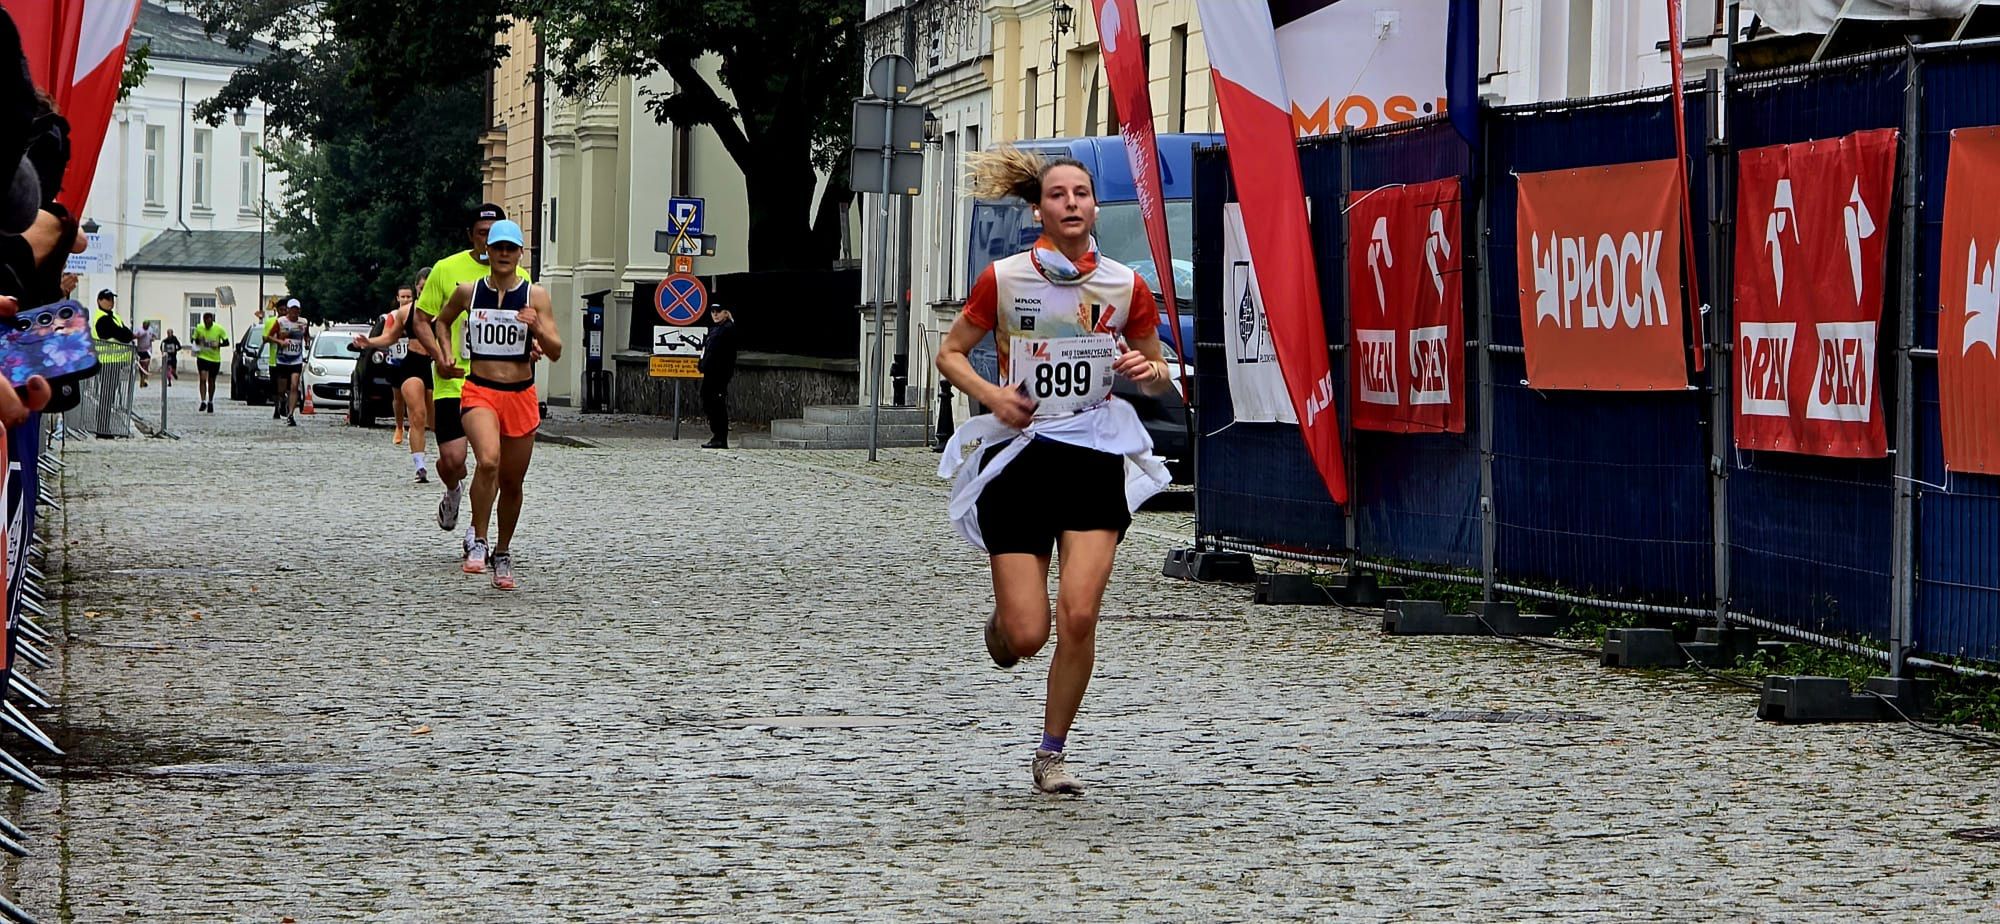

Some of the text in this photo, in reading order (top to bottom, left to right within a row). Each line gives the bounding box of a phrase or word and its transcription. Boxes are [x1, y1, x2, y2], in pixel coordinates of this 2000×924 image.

[1561, 231, 1669, 329] PŁOCK
[476, 323, 518, 346] 1006
[1035, 360, 1092, 398] 899
